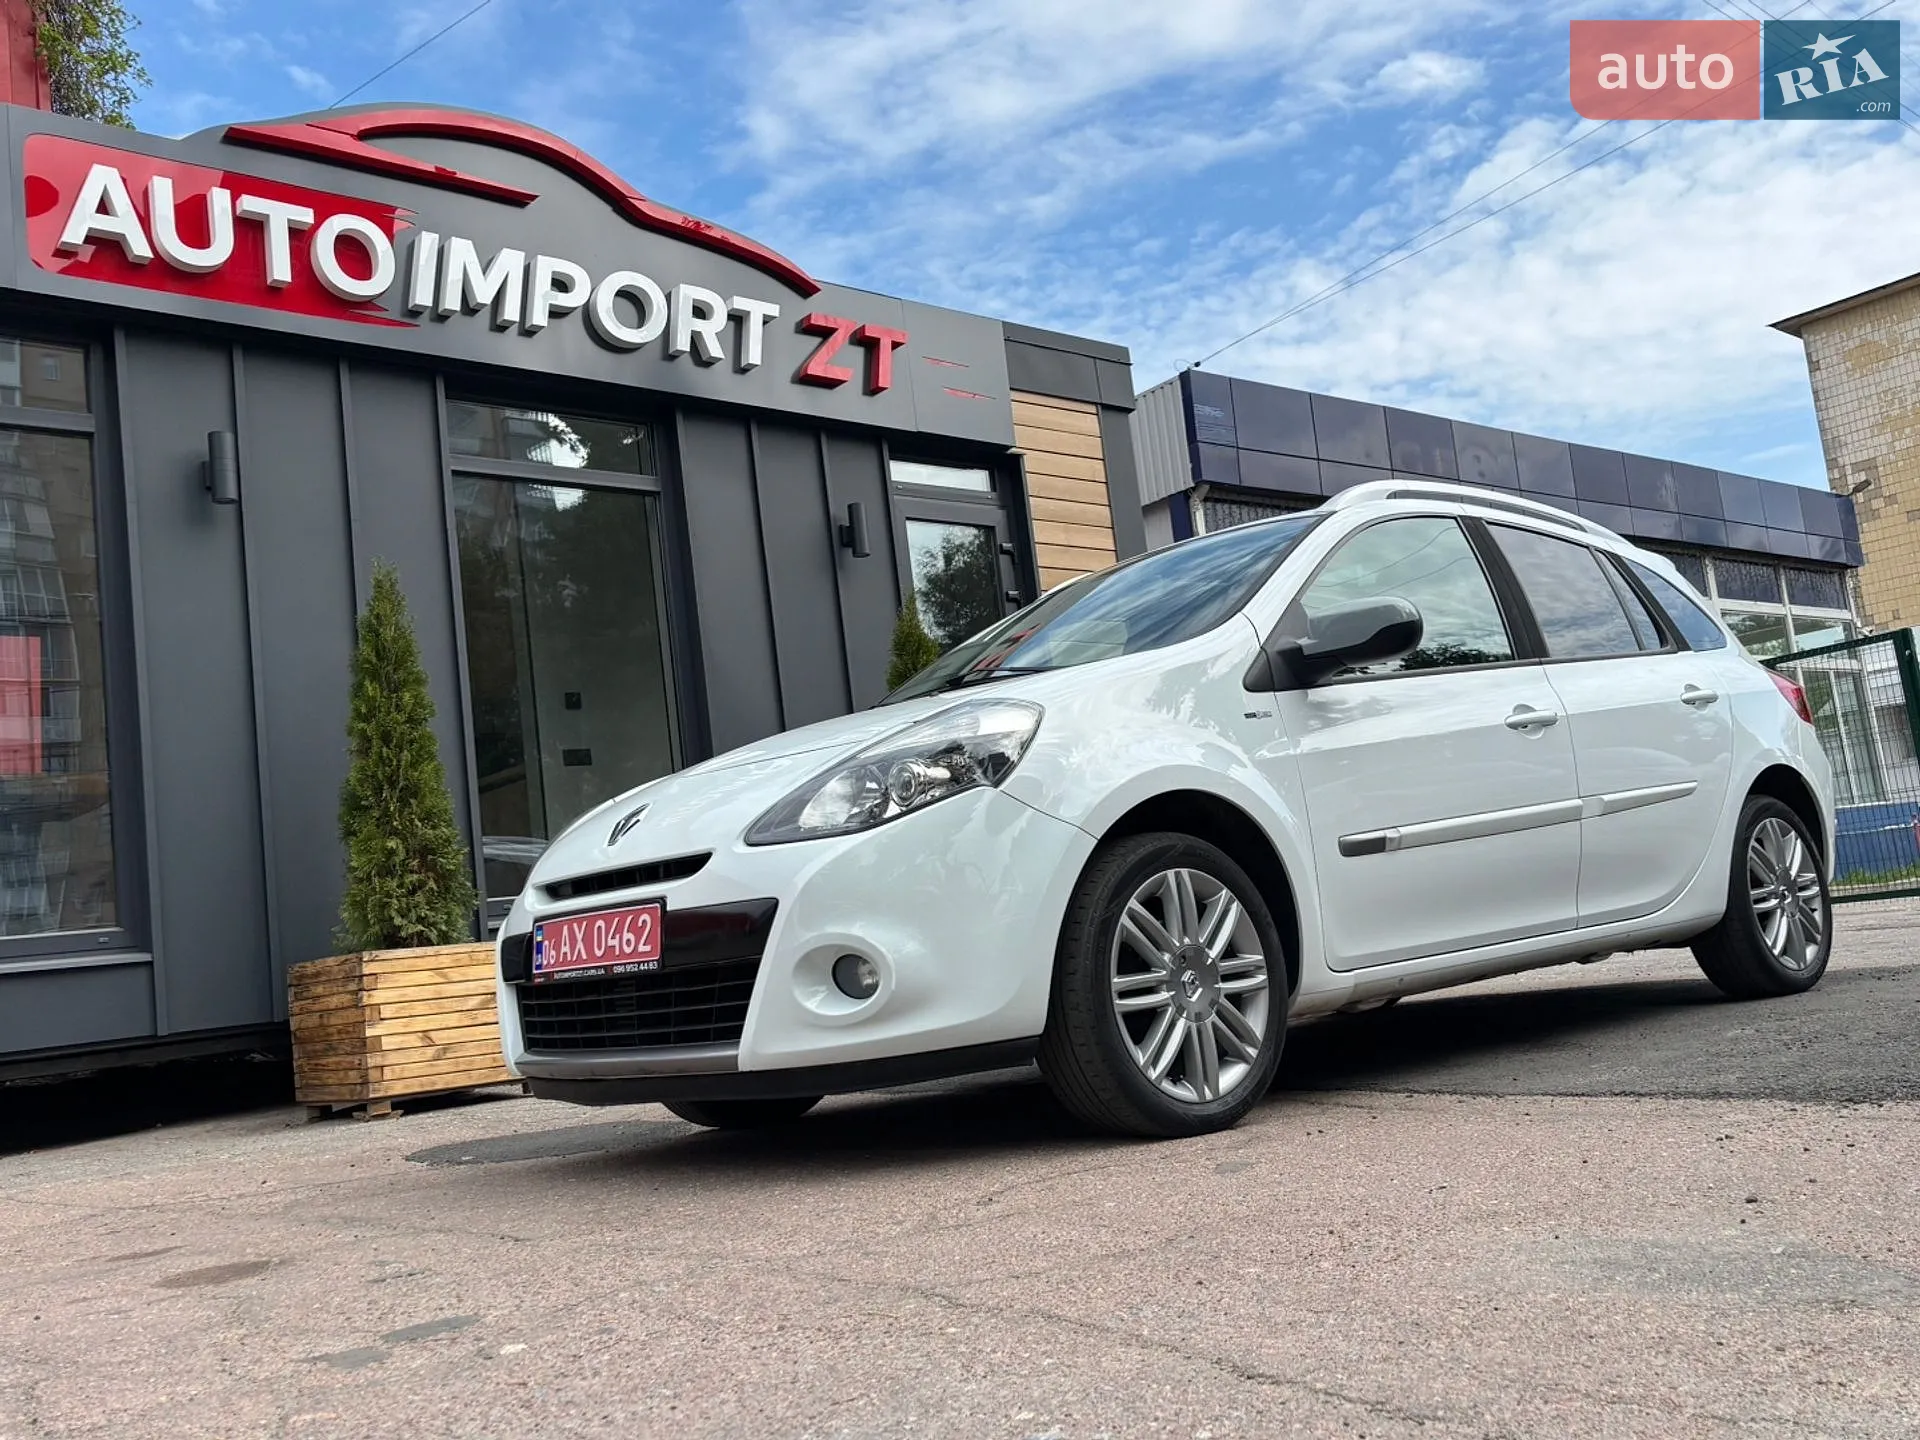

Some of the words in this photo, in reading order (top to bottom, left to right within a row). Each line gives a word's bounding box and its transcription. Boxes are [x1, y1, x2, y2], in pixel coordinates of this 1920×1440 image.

[798, 312, 908, 395] ZT
[543, 940, 556, 965] 06
[560, 921, 587, 961] AX
[594, 913, 651, 957] 0462
